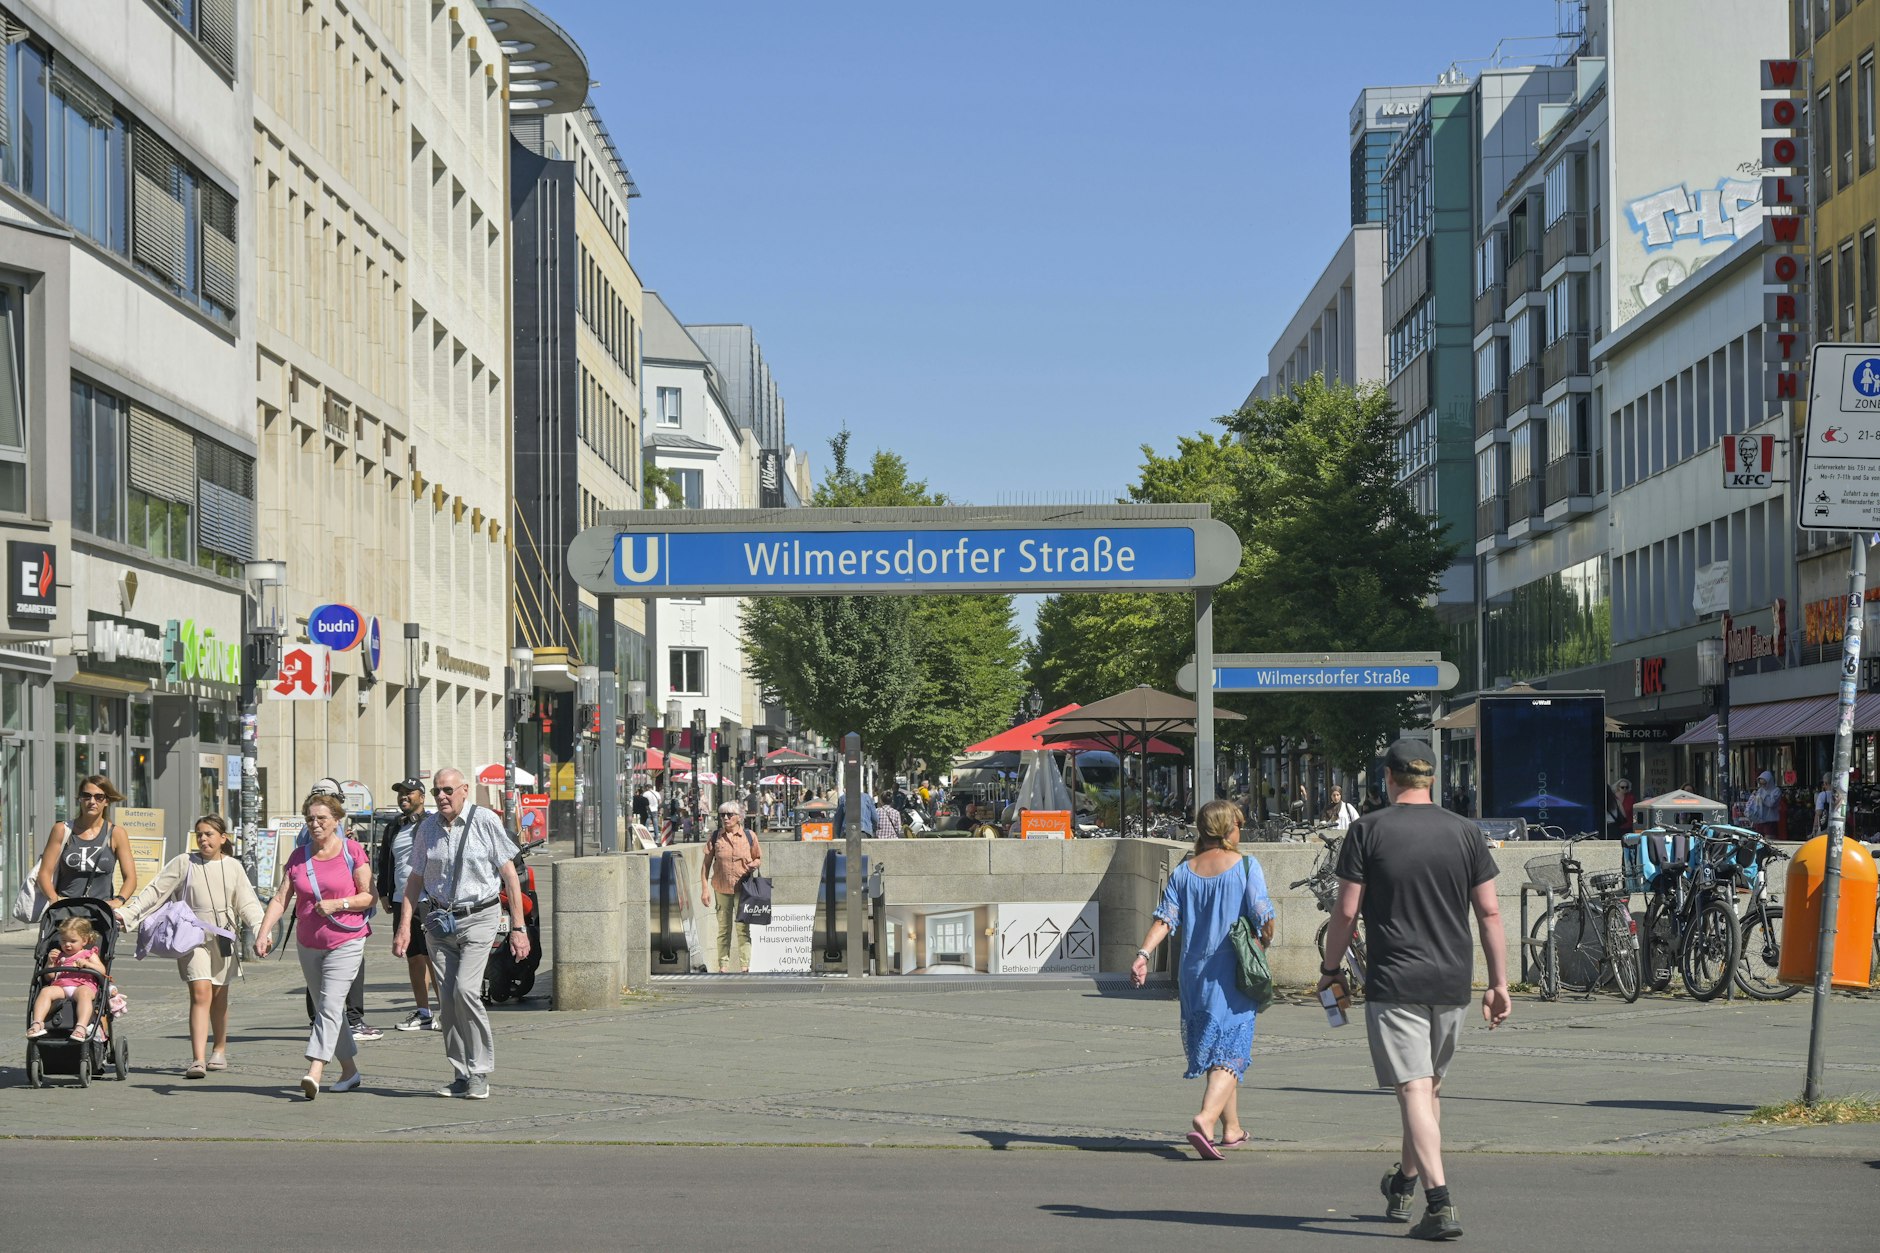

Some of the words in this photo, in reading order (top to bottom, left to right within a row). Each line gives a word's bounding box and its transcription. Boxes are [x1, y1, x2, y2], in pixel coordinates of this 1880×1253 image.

[1768, 61, 1800, 398] WOOLWORTH
[1732, 474, 1765, 486] KFC
[621, 536, 659, 582] U
[744, 537, 1005, 576] Wilmersdorfer
[1019, 535, 1136, 573] Straße
[22, 561, 38, 597] E
[318, 619, 354, 632] budni
[1257, 669, 1359, 686] Wilmersdorfer
[1364, 668, 1410, 684] Straße
[1643, 657, 1664, 694] KFC
[1633, 730, 1650, 738] FOR
[744, 904, 772, 914] KaDeWe
